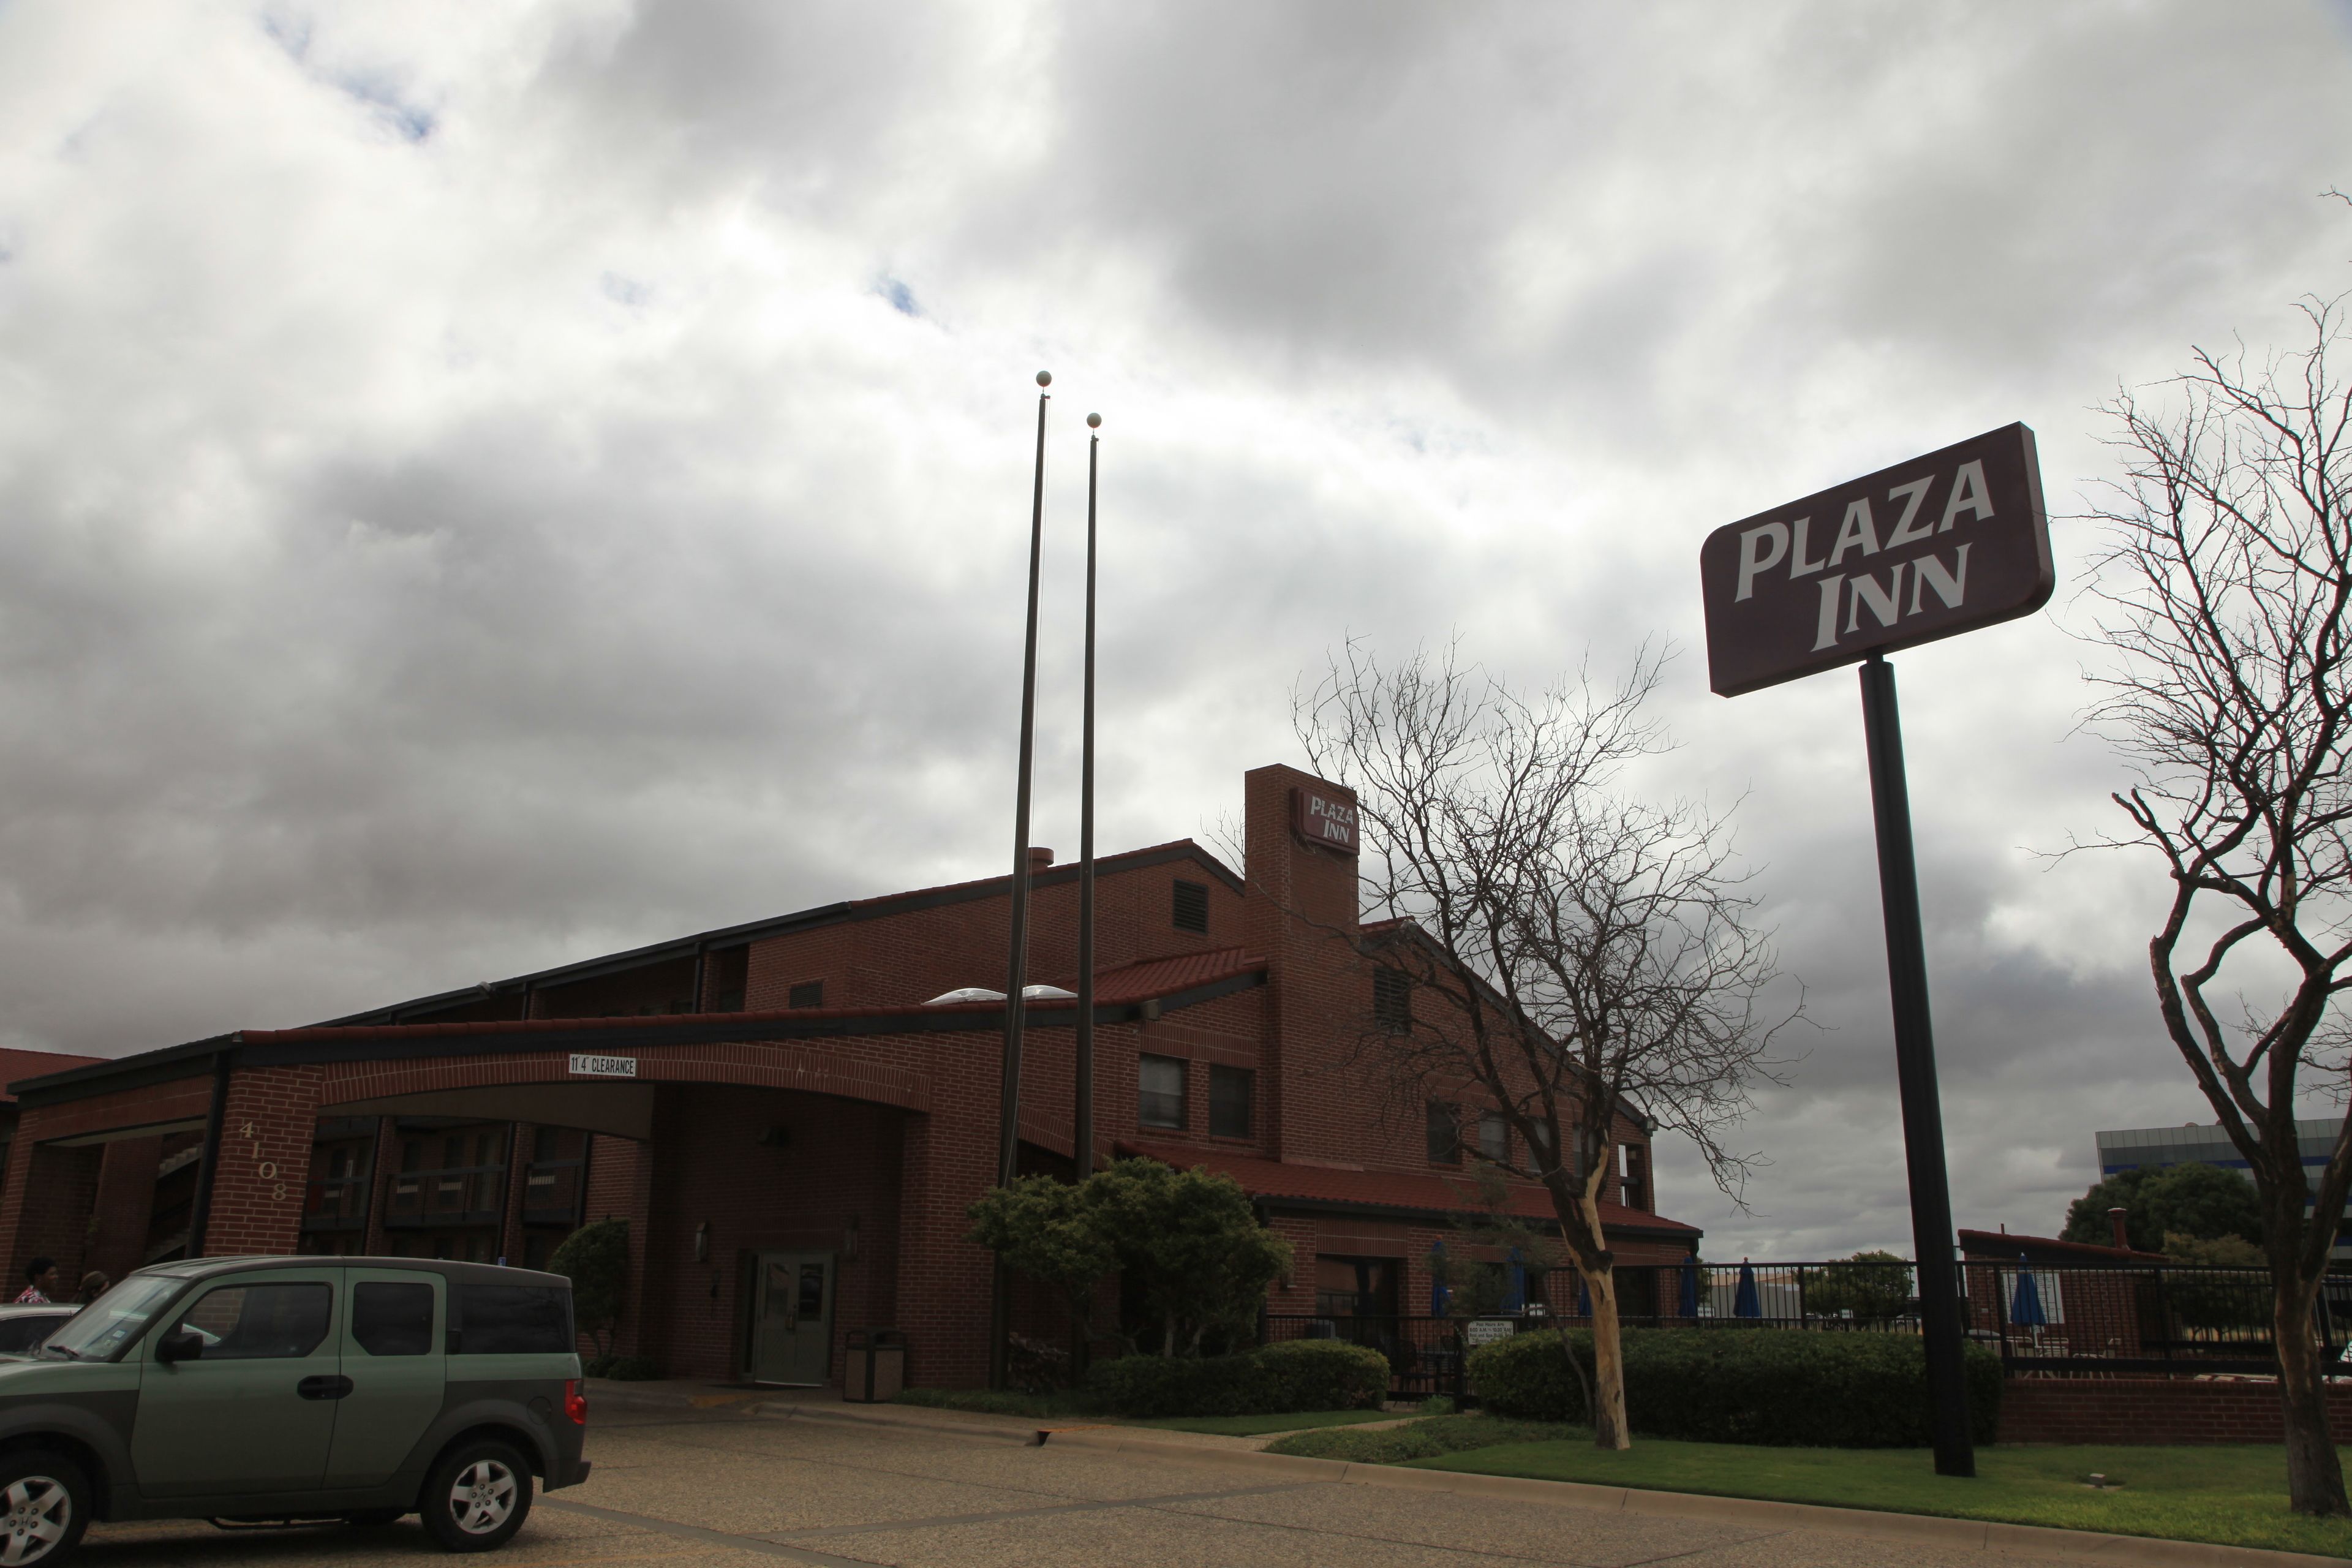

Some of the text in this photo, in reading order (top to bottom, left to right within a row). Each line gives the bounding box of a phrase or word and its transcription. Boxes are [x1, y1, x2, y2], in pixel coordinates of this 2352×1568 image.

[1735, 458, 1995, 603] PLAZA
[1810, 543, 1973, 652] INN
[1310, 796, 1354, 825] PLAZA
[1323, 820, 1350, 843] INN
[592, 1058, 635, 1074] CLEARANCE
[239, 1121, 287, 1200] 4108
